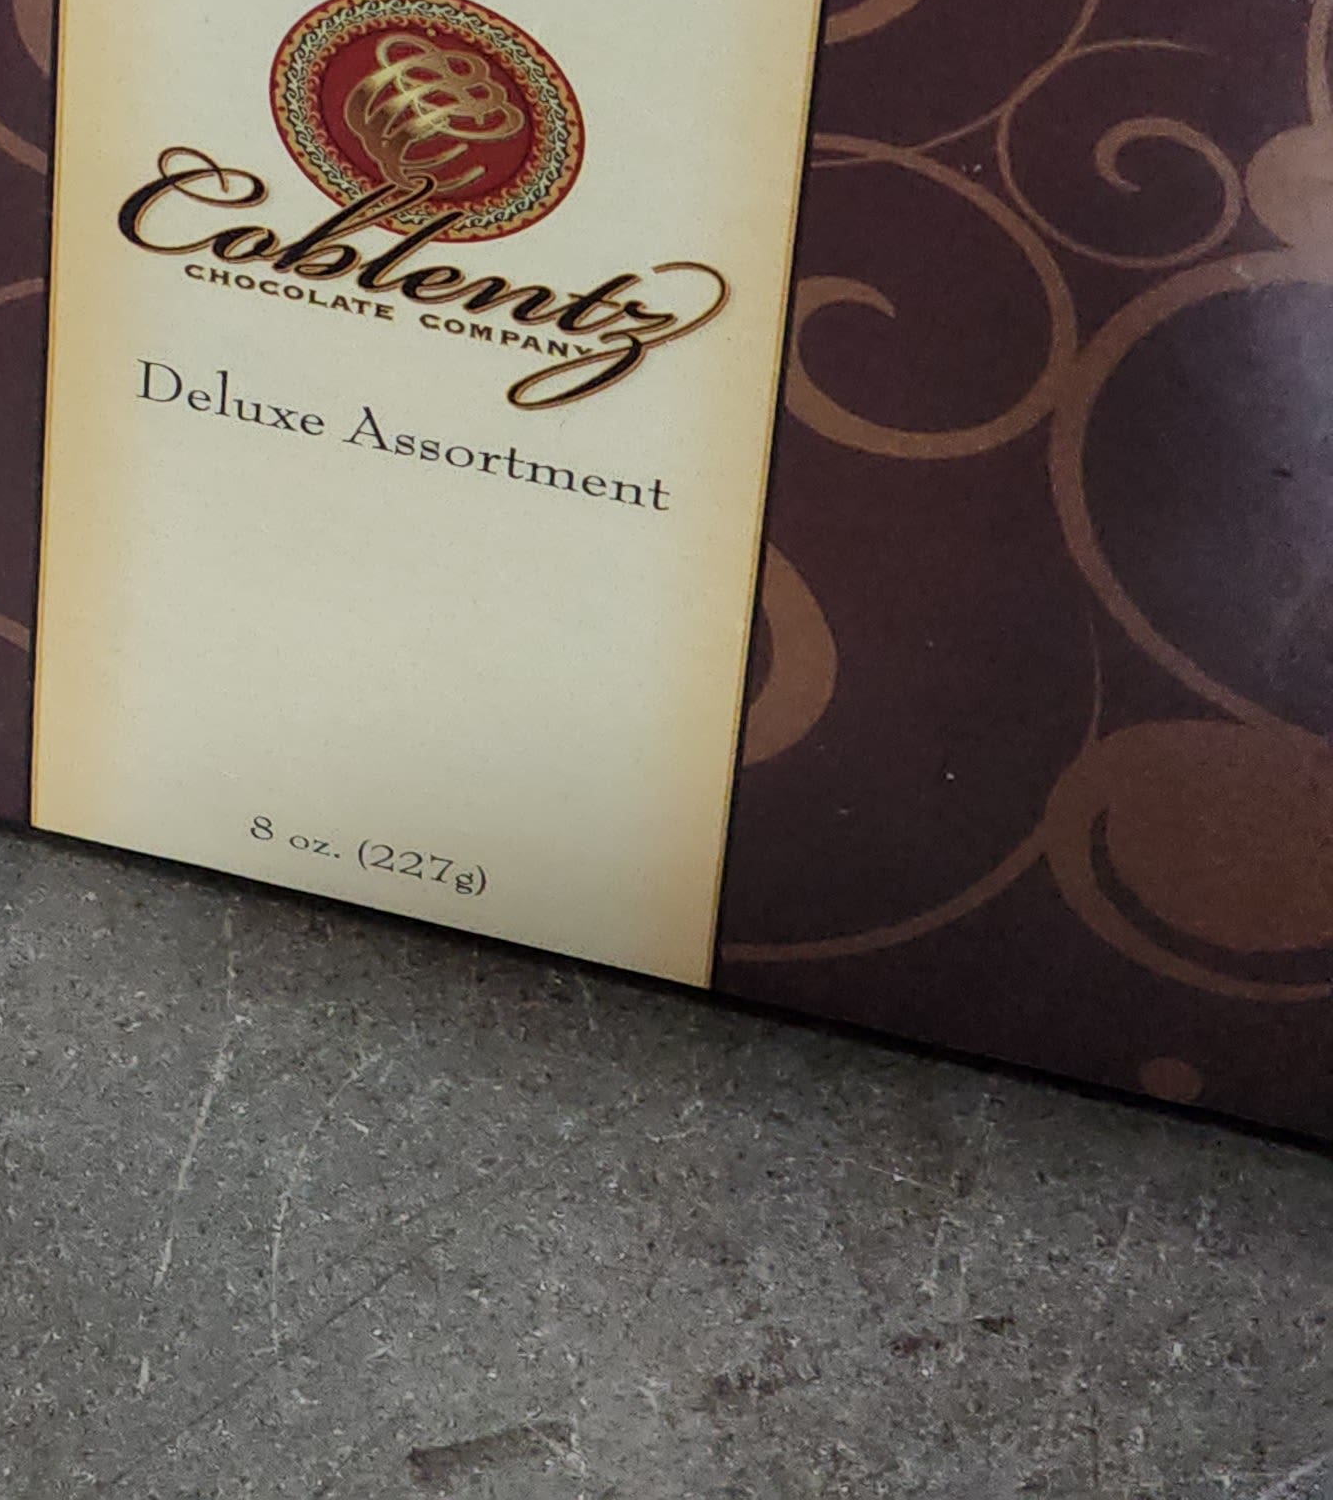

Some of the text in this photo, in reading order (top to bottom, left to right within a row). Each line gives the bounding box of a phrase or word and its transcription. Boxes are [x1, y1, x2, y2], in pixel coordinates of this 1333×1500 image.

[117, 147, 730, 411] Coblentz
[185, 262, 596, 360] CHOCOLATE COMPANY
[135, 358, 671, 512] Deluxe Assortment
[250, 815, 487, 896] 8 oz. (227g)
